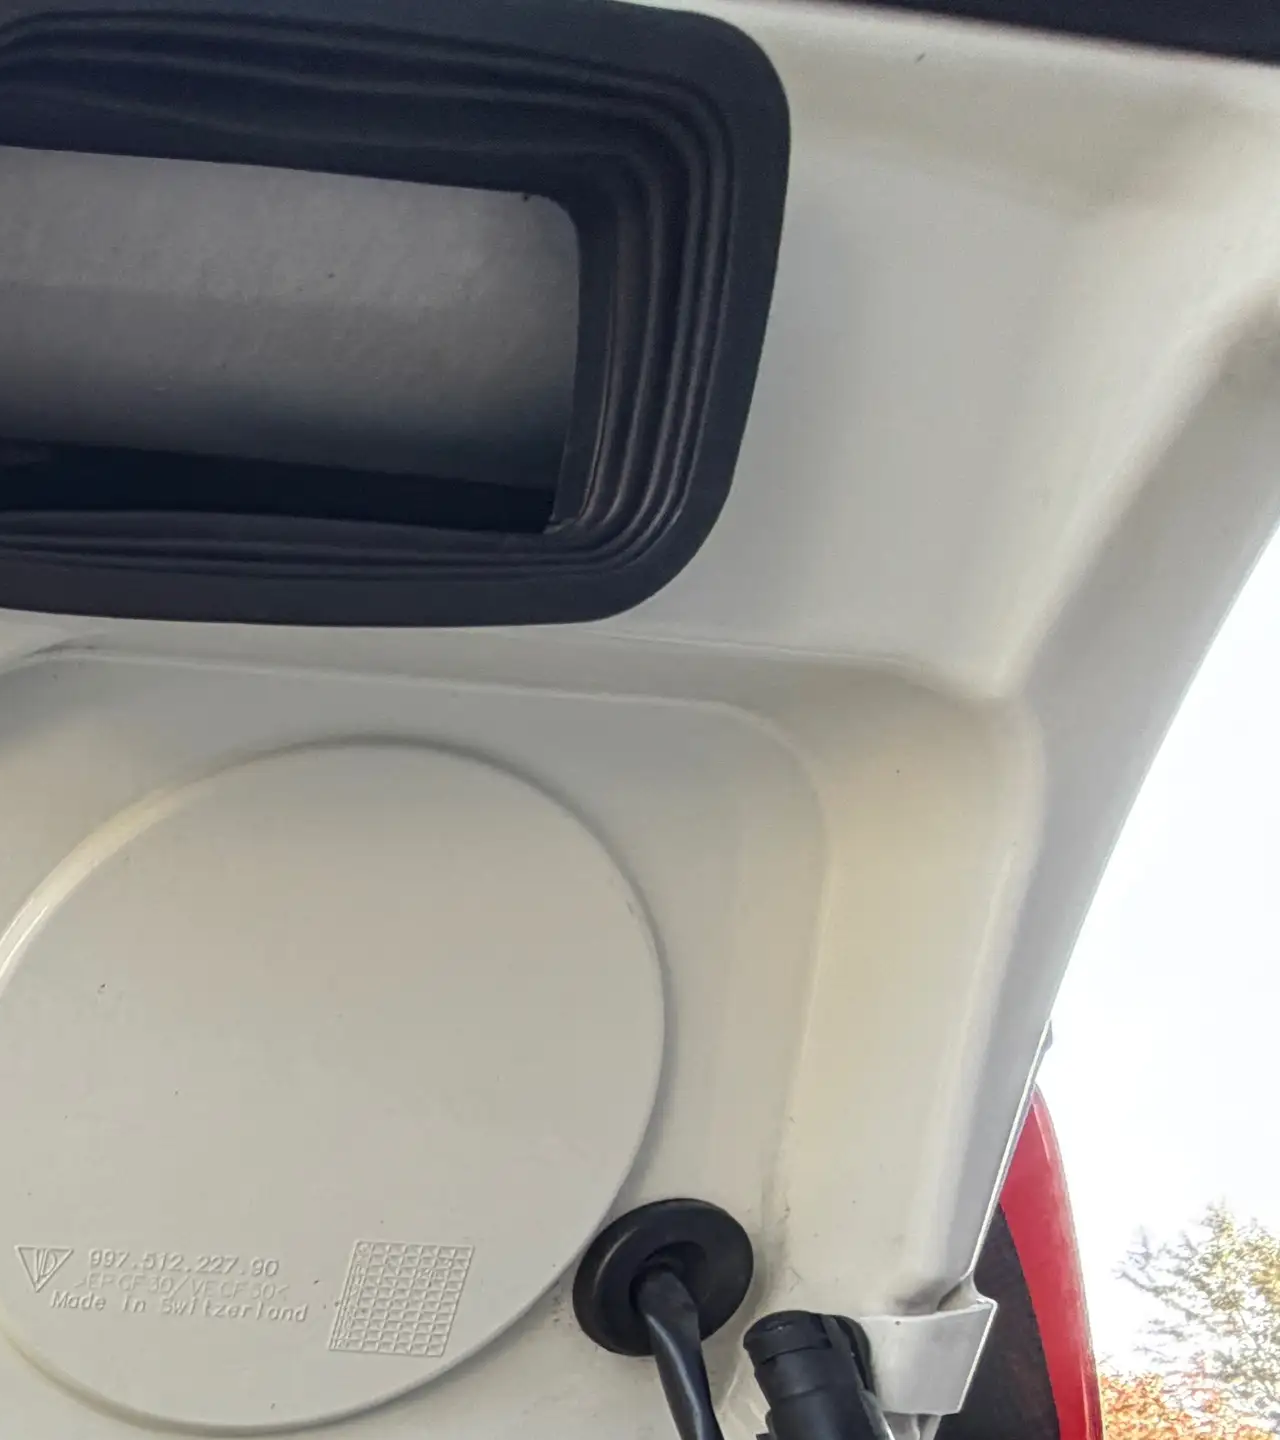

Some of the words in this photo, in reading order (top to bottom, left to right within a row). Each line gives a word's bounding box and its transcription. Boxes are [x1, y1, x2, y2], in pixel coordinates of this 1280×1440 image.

[88, 1247, 280, 1278] 997.512.227.90
[50, 1289, 106, 1311] Made
[122, 1294, 146, 1313] in
[161, 1298, 309, 1324] Switzerland
